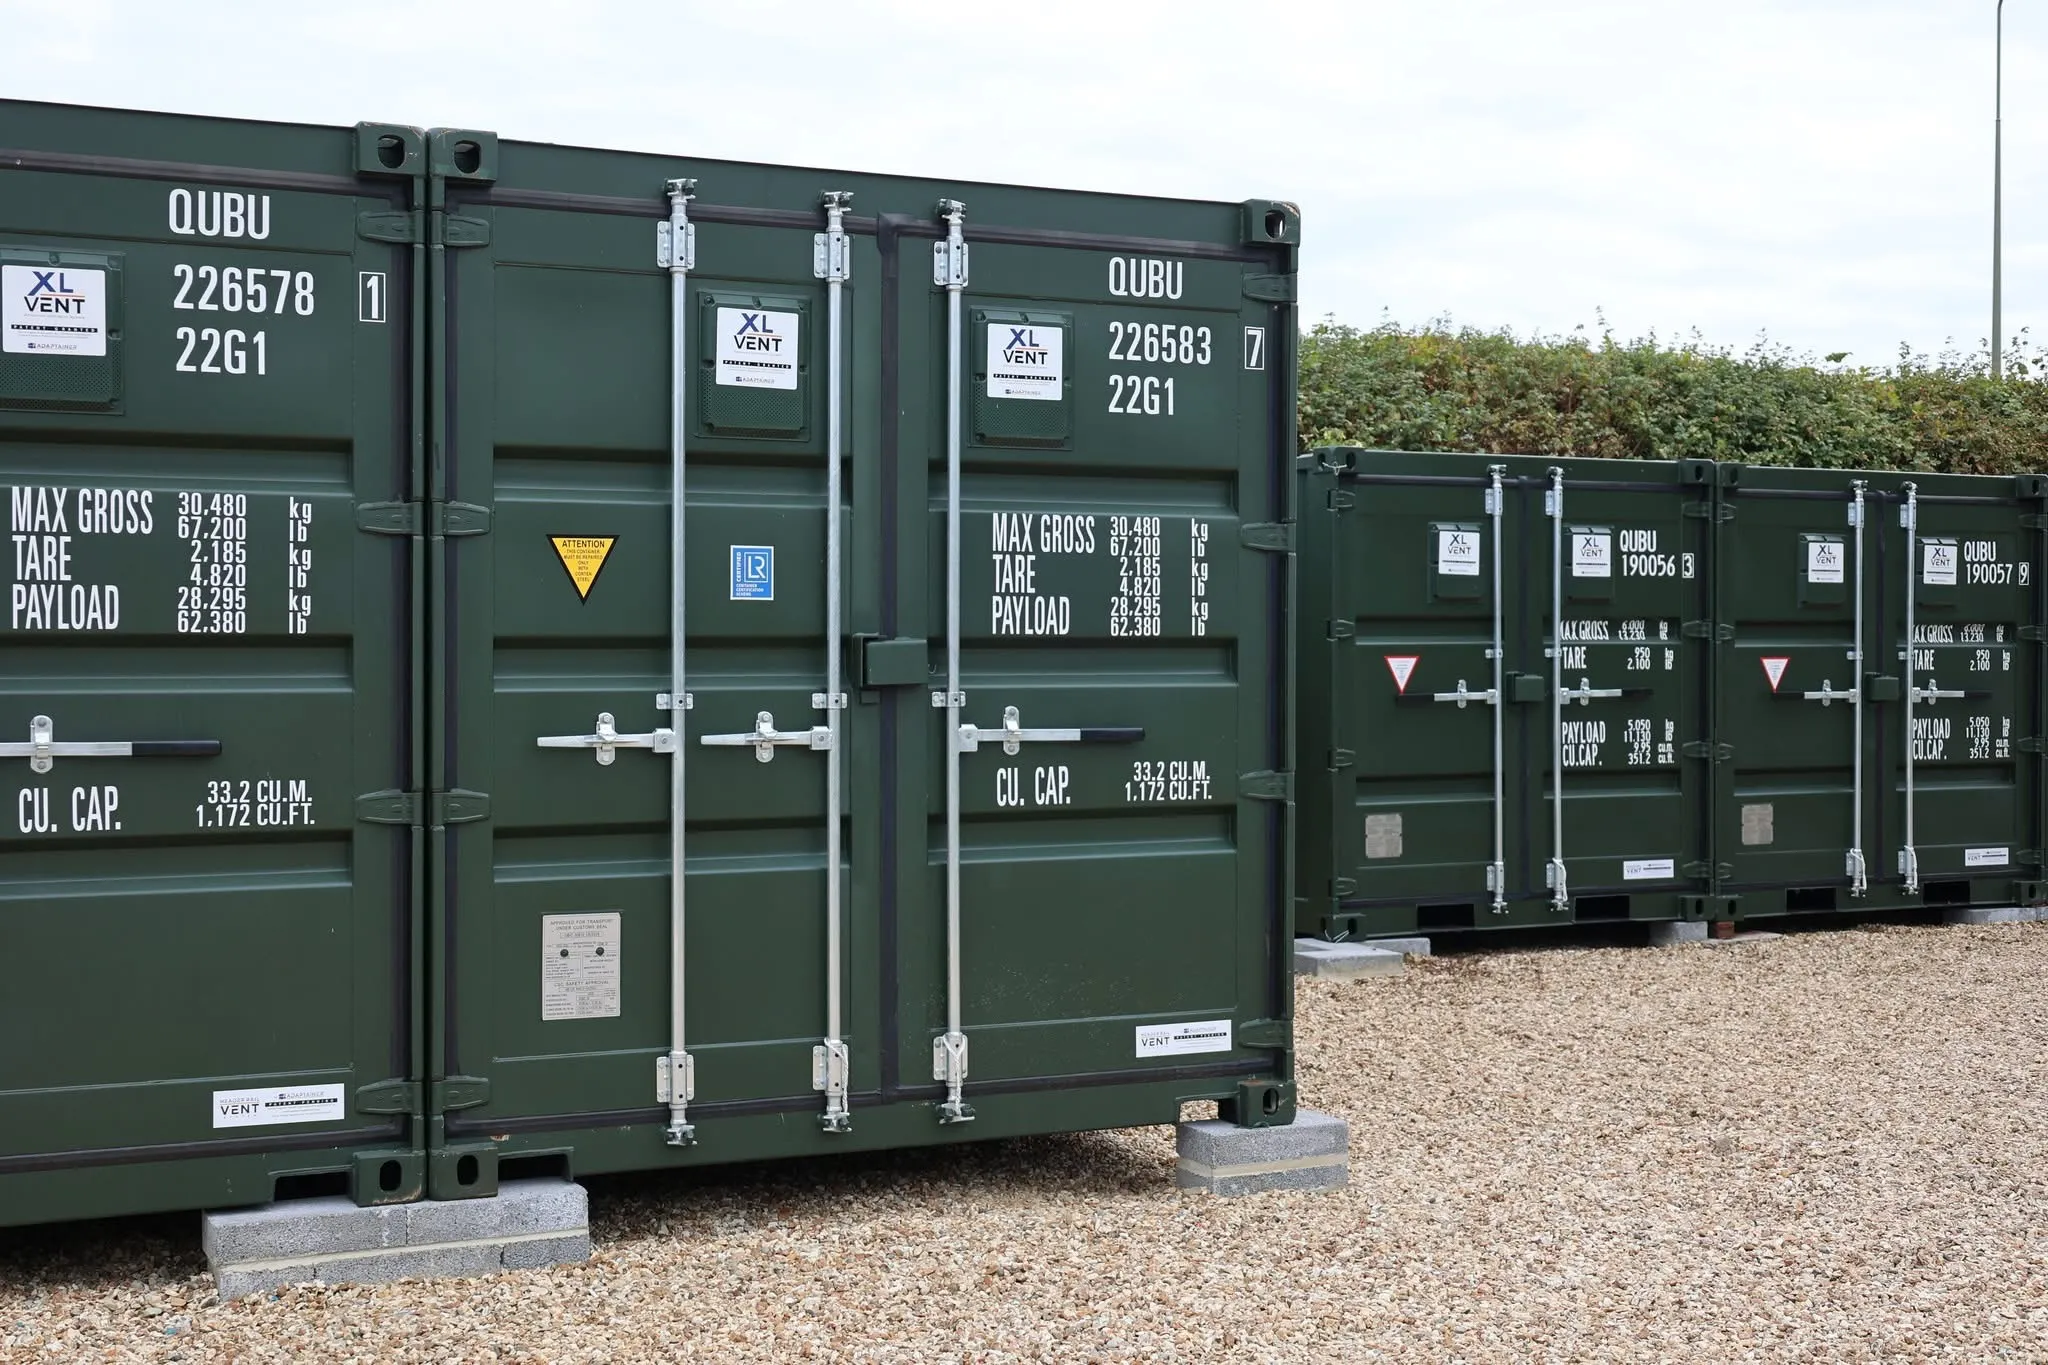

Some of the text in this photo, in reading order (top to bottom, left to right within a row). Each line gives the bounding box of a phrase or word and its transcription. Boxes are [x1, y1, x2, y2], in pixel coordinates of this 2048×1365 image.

[169, 188, 270, 239] QUBU
[27, 271, 74, 296] XL
[1109, 256, 1183, 299] QUBU
[174, 264, 379, 319] 226578 1
[24, 296, 85, 314] VENT
[737, 313, 773, 335] XL
[734, 335, 782, 352] VENT
[1006, 328, 1039, 349] XL
[1109, 321, 1262, 367] 226583 7
[176, 327, 266, 375] 22G1
[1003, 350, 1048, 364] VENT
[1108, 374, 1174, 415] 22G1
[12, 486, 153, 534] MAX GROSS
[178, 492, 312, 524] 30,480 kg
[178, 516, 307, 542] 67,200 lb
[992, 513, 1095, 553] MAX GROSS
[1110, 516, 1208, 541] 30,480 kg
[562, 540, 605, 548] ATTENTION
[1110, 537, 1205, 557] 67,200 lb
[1450, 534, 1467, 546] XL
[1582, 537, 1599, 549] XL
[1620, 530, 1656, 552] QUBU
[1818, 545, 1832, 556] XL
[12, 535, 72, 581] TARE
[190, 540, 312, 570] 2,185 kg
[1932, 547, 1947, 559] XL
[1964, 541, 1996, 562] QUBU
[190, 563, 307, 588] 4,820 lb
[748, 556, 766, 578] LR
[992, 554, 1036, 593] TARE
[1120, 557, 1208, 581] 2,185 kg
[1622, 554, 1693, 576] 190056 3
[1966, 564, 2028, 584] 190057 9
[1120, 577, 1205, 596] 4,820 lb
[12, 584, 119, 630] PAYLOAD
[178, 587, 312, 616] 28,295 kg
[1110, 597, 1208, 620] 28,295 kg
[178, 610, 307, 634] 62,380 lb
[992, 595, 1070, 635] PAYLOAD
[1110, 616, 1205, 636] 62,380 lb
[1579, 620, 1609, 640] GROSS
[1913, 625, 1953, 643] AX GROSS
[1563, 646, 1587, 669] TARE
[1627, 658, 1673, 670] 2.100 lb
[1634, 647, 1674, 661] 950 kg
[1913, 649, 1935, 671] TARE
[1976, 649, 2010, 662] 950 kg
[1969, 660, 2010, 671] 2.100 lb
[1562, 721, 1606, 744] PAYLOAD
[1627, 719, 1674, 732] 5.050 kg
[1912, 718, 1951, 739] PAYLOAD
[1966, 727, 2009, 738] 11.130 lb
[1969, 716, 2010, 728] 5.050 kg
[1624, 731, 1673, 742] 11.130 lb
[1974, 738, 1989, 748] 9.95
[1634, 742, 1651, 753] 9.95
[1969, 748, 1989, 759] 351.2
[1628, 753, 1651, 765] 351.2
[1133, 761, 1210, 781] 33.2 CU.M.
[207, 780, 313, 804] 33.2 CU.M.
[996, 766, 1071, 806] CU. CAP.
[1125, 780, 1212, 801] 1,172 CU.FT.
[18, 786, 121, 833] CU. CAP.
[196, 802, 315, 827] 1,172 CU.FT.
[1142, 1037, 1170, 1046] VENT
[221, 1104, 259, 1116] VENT
